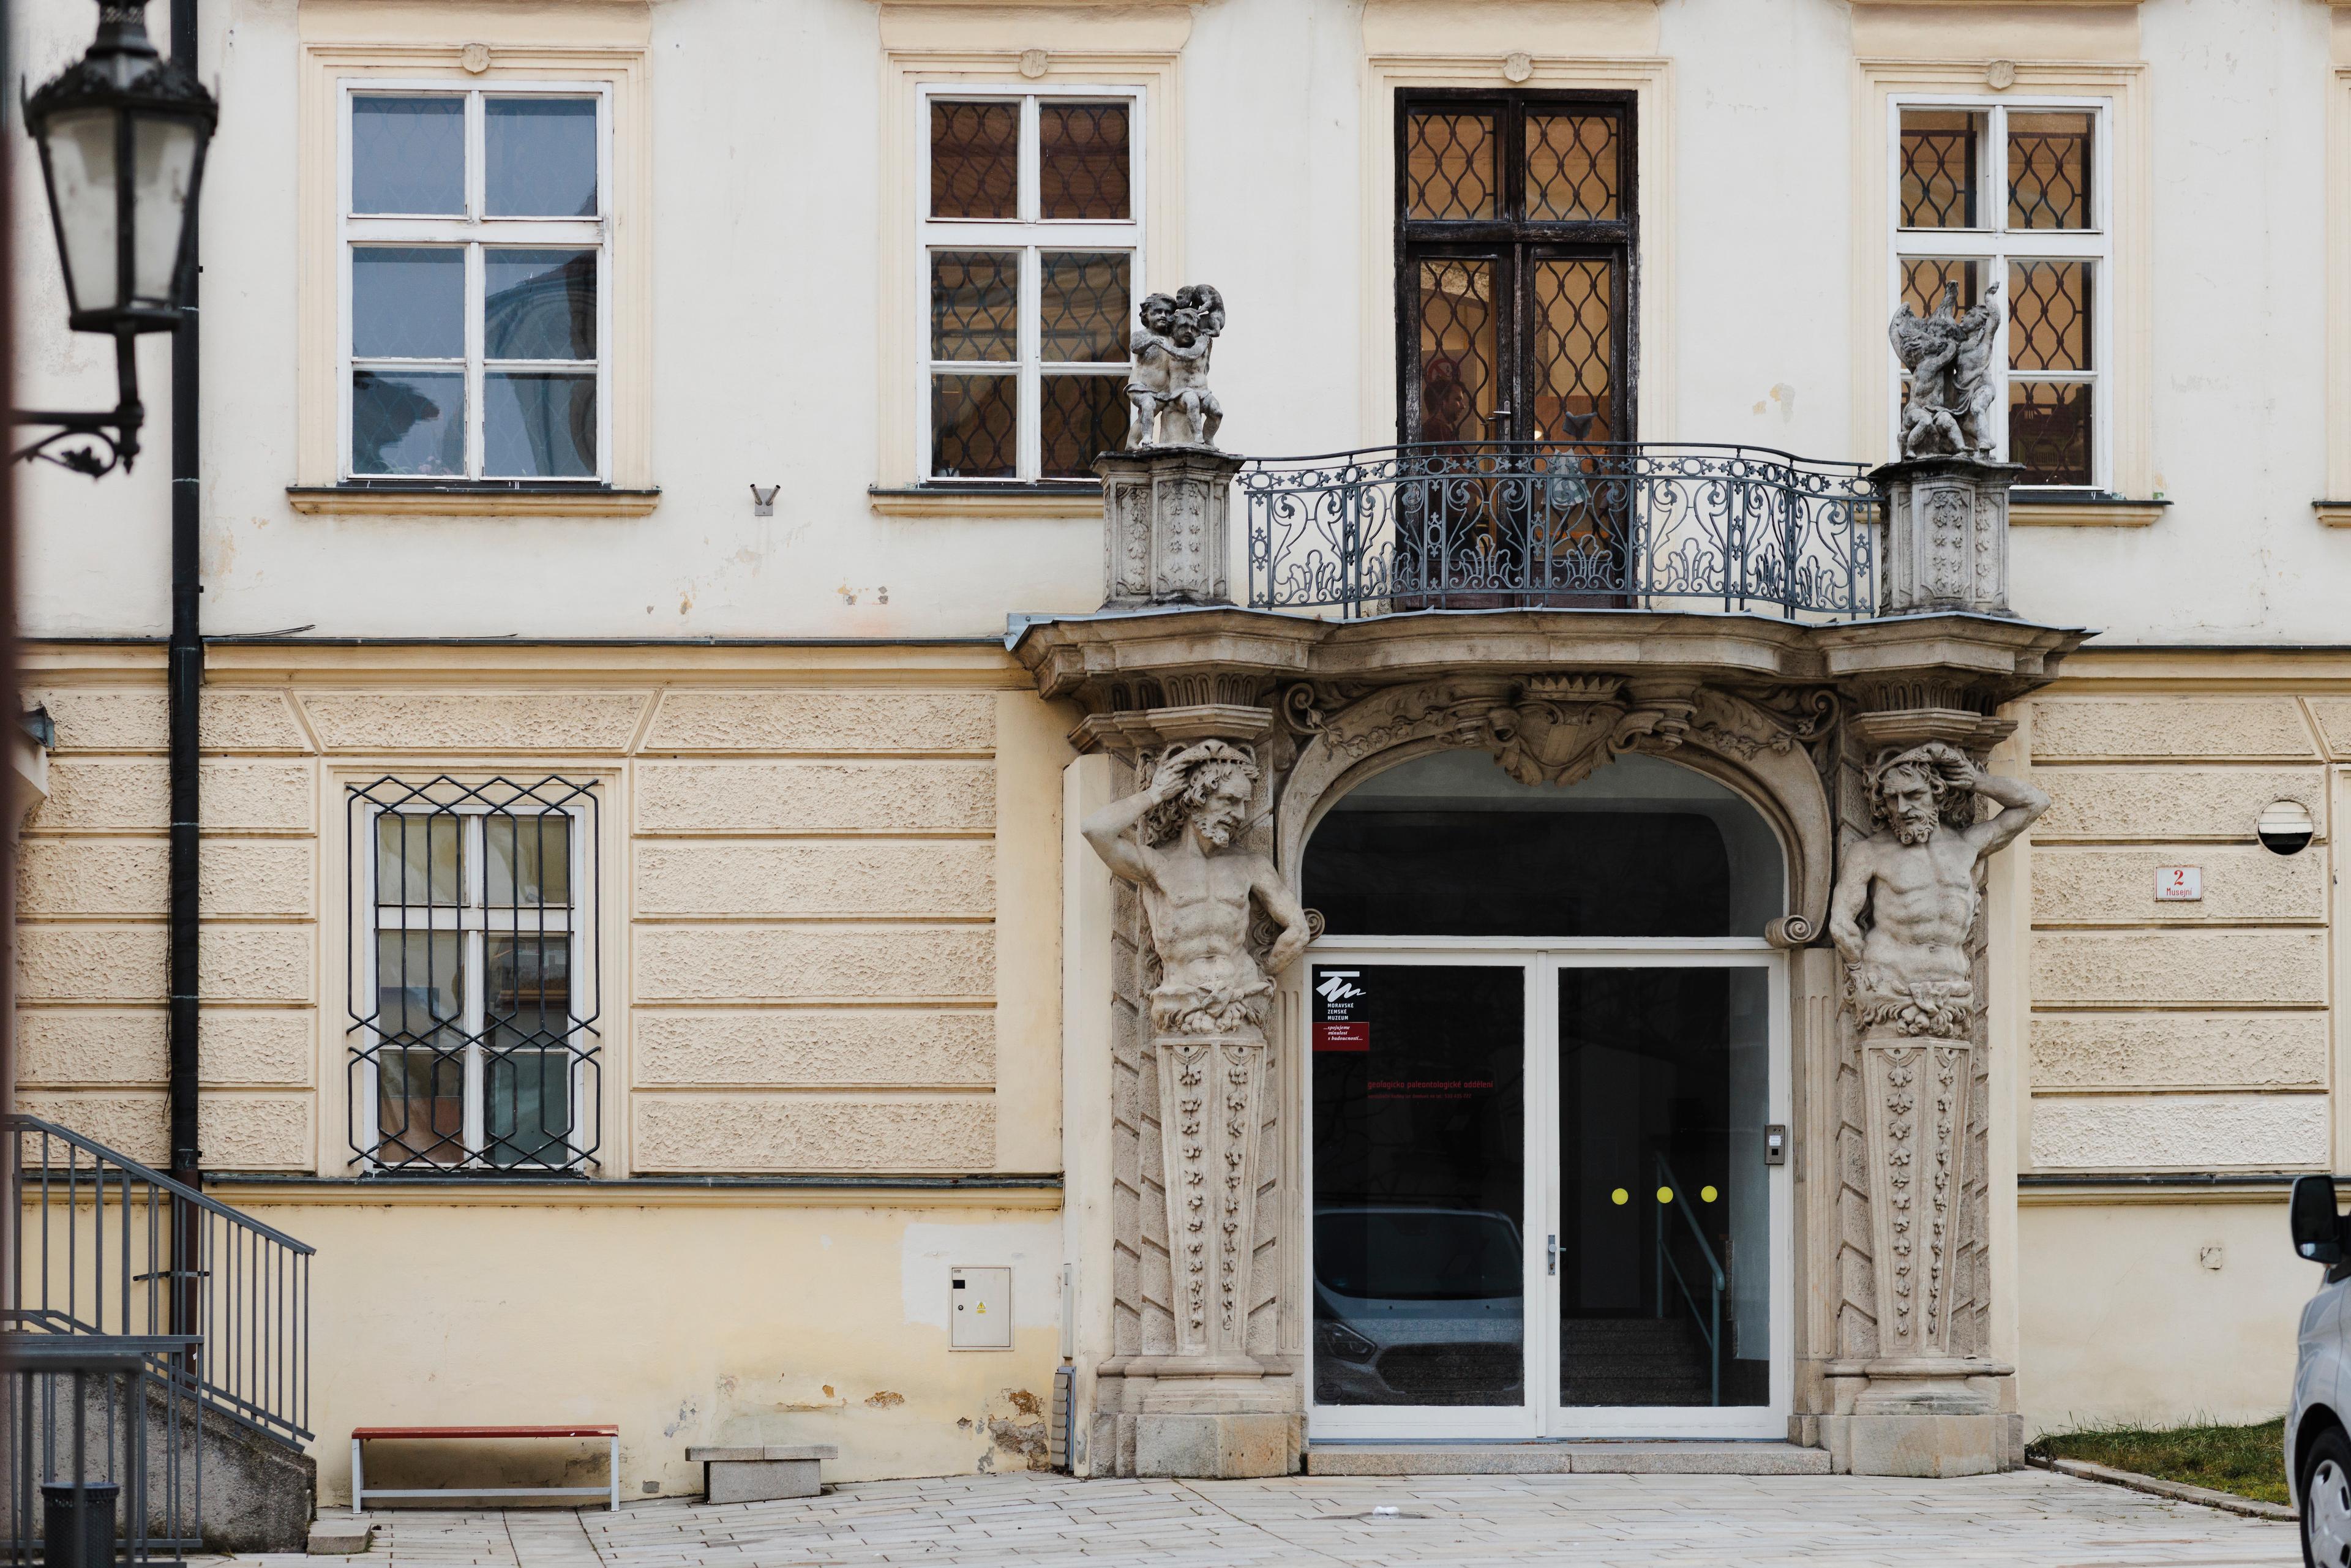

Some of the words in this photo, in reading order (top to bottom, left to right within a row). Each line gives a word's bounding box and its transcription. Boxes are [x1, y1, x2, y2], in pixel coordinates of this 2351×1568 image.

[2174, 869, 2184, 886] 2
[2166, 887, 2192, 898] Musejní
[1368, 1080, 1404, 1090] geologicko
[1407, 1080, 1461, 1090] paleontologické
